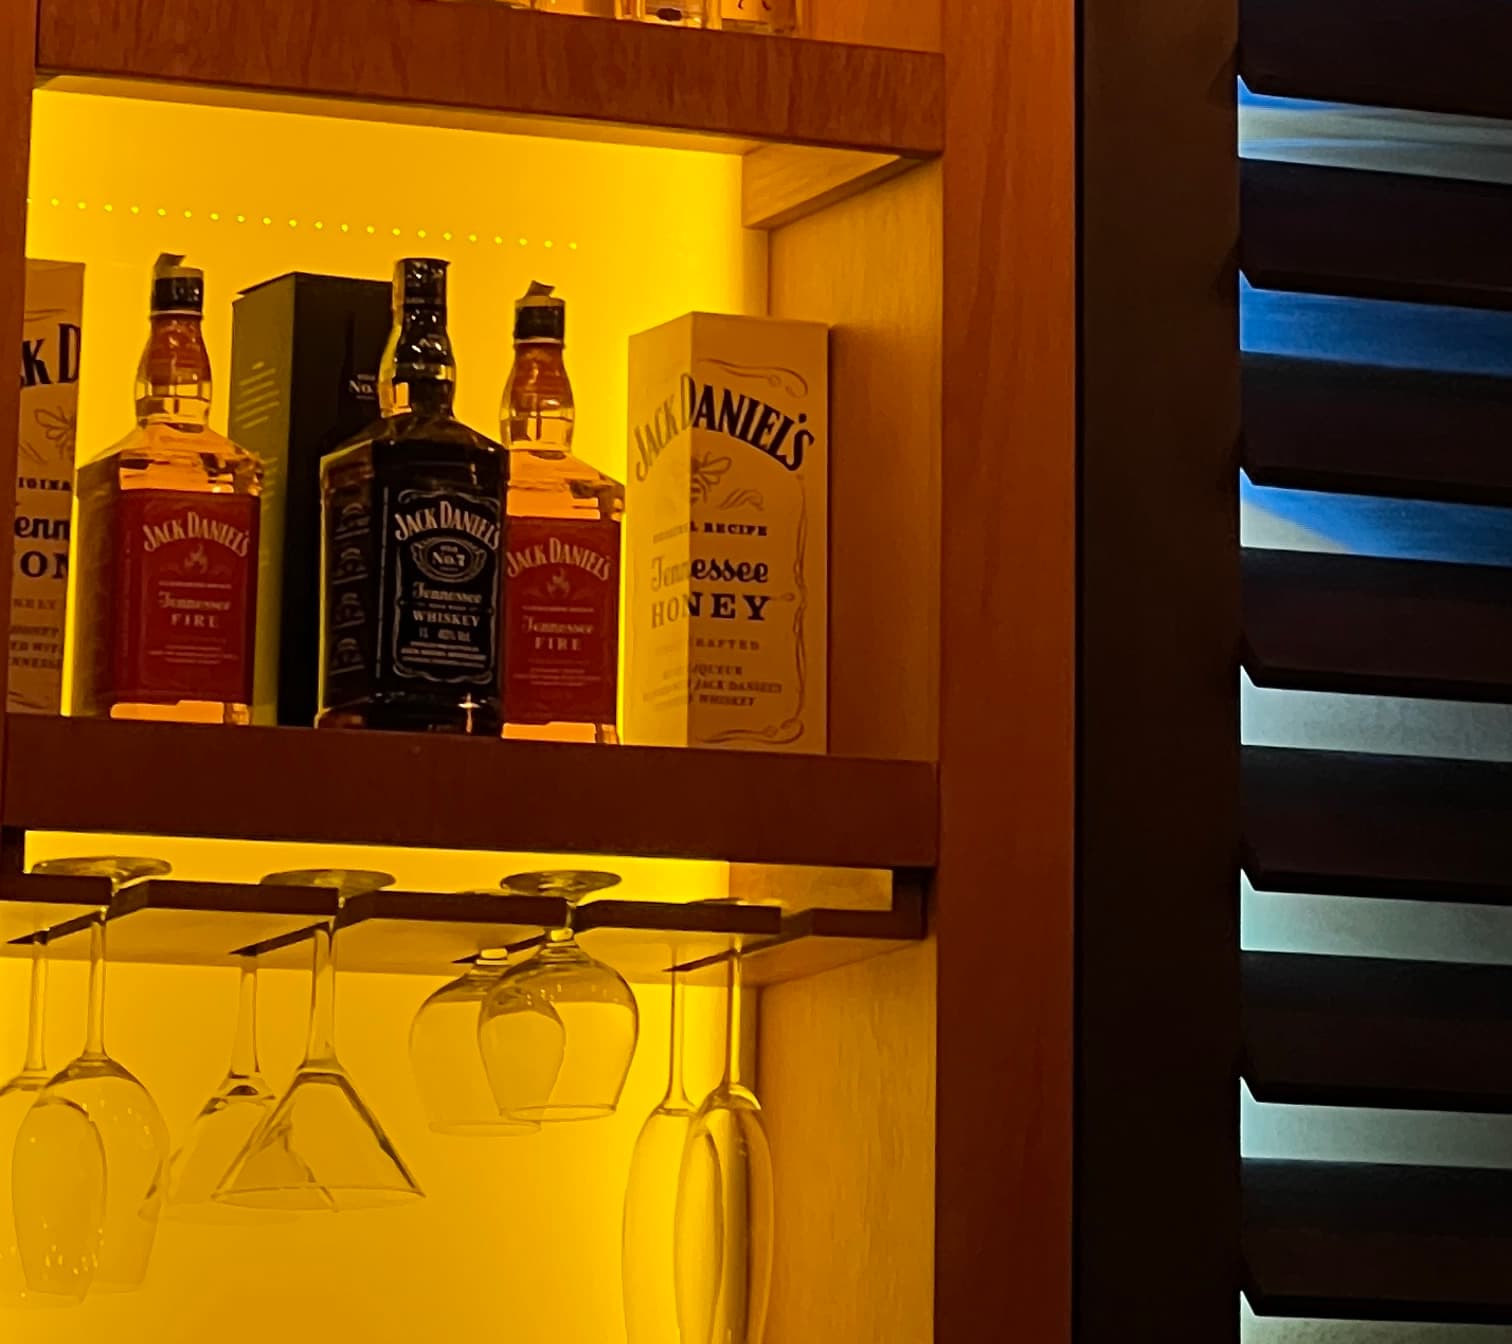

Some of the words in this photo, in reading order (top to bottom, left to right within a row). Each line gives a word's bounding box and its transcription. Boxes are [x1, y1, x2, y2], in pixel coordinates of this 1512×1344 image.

[633, 394, 679, 482] JACK
[680, 372, 815, 471] DANIEL'S
[394, 507, 439, 541] JACK
[703, 521, 768, 537] RECIPE
[142, 519, 187, 552] JACK
[187, 511, 249, 557] DANIEL'S
[431, 550, 466, 568] No.7
[506, 543, 548, 578] JACK
[549, 536, 611, 581] DANIEL'S
[412, 610, 480, 627] WHISKEY
[651, 591, 771, 630] HONEY
[171, 613, 219, 628] FIRE
[534, 636, 582, 652] FIRE
[694, 637, 760, 651] RAFTED
